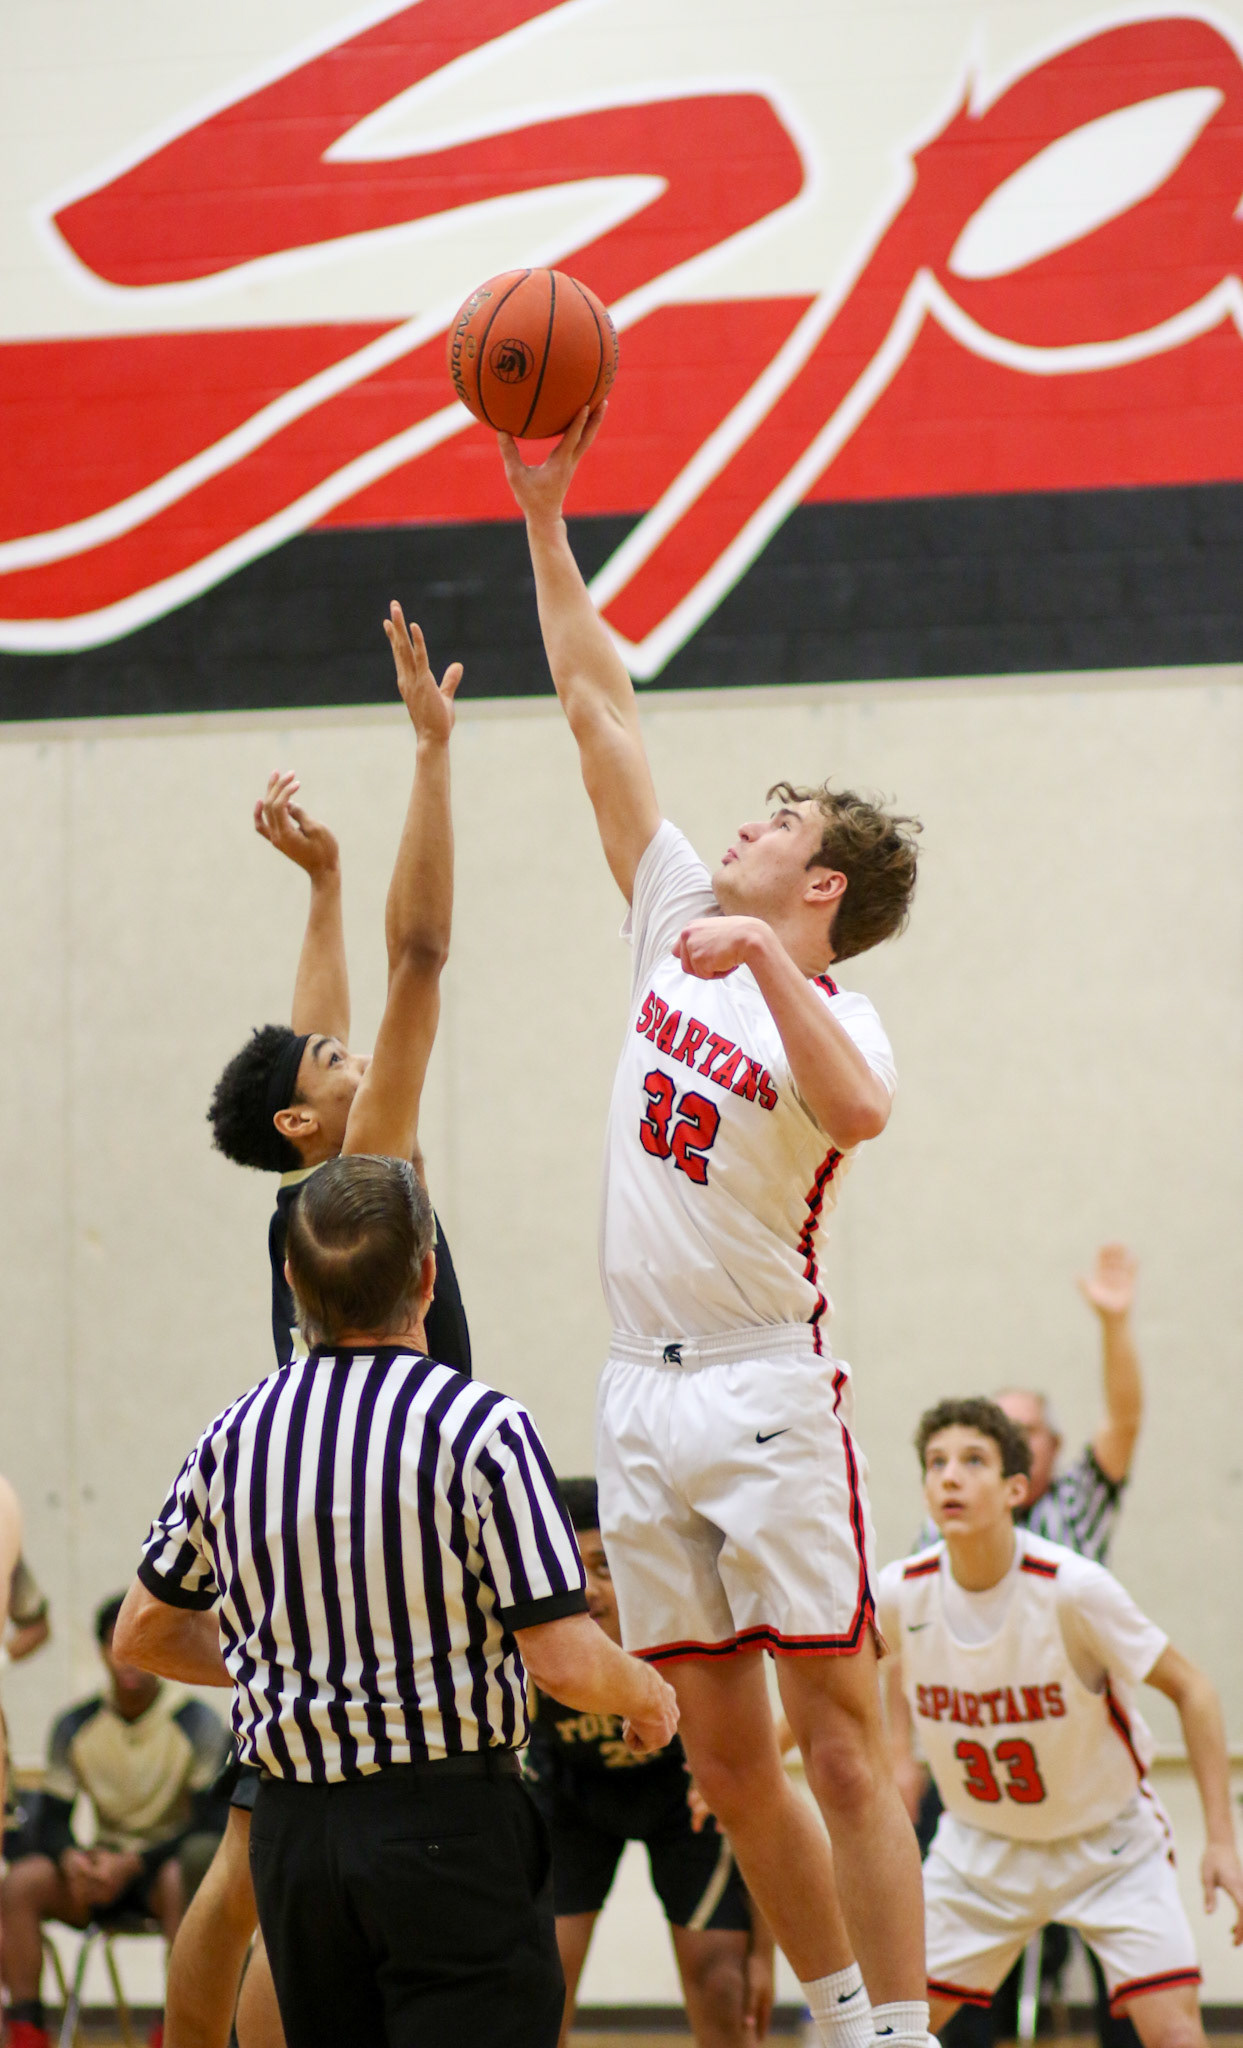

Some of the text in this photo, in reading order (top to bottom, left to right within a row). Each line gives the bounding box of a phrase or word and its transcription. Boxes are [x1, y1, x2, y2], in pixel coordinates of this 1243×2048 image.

[0, 0, 1243, 684] Sp
[451, 288, 493, 402] SPALDING
[636, 990, 779, 1111] SPARTANS
[639, 1068, 721, 1186] 32
[916, 1682, 1067, 1728] SPARTANS
[954, 1738, 1047, 1804] 33
